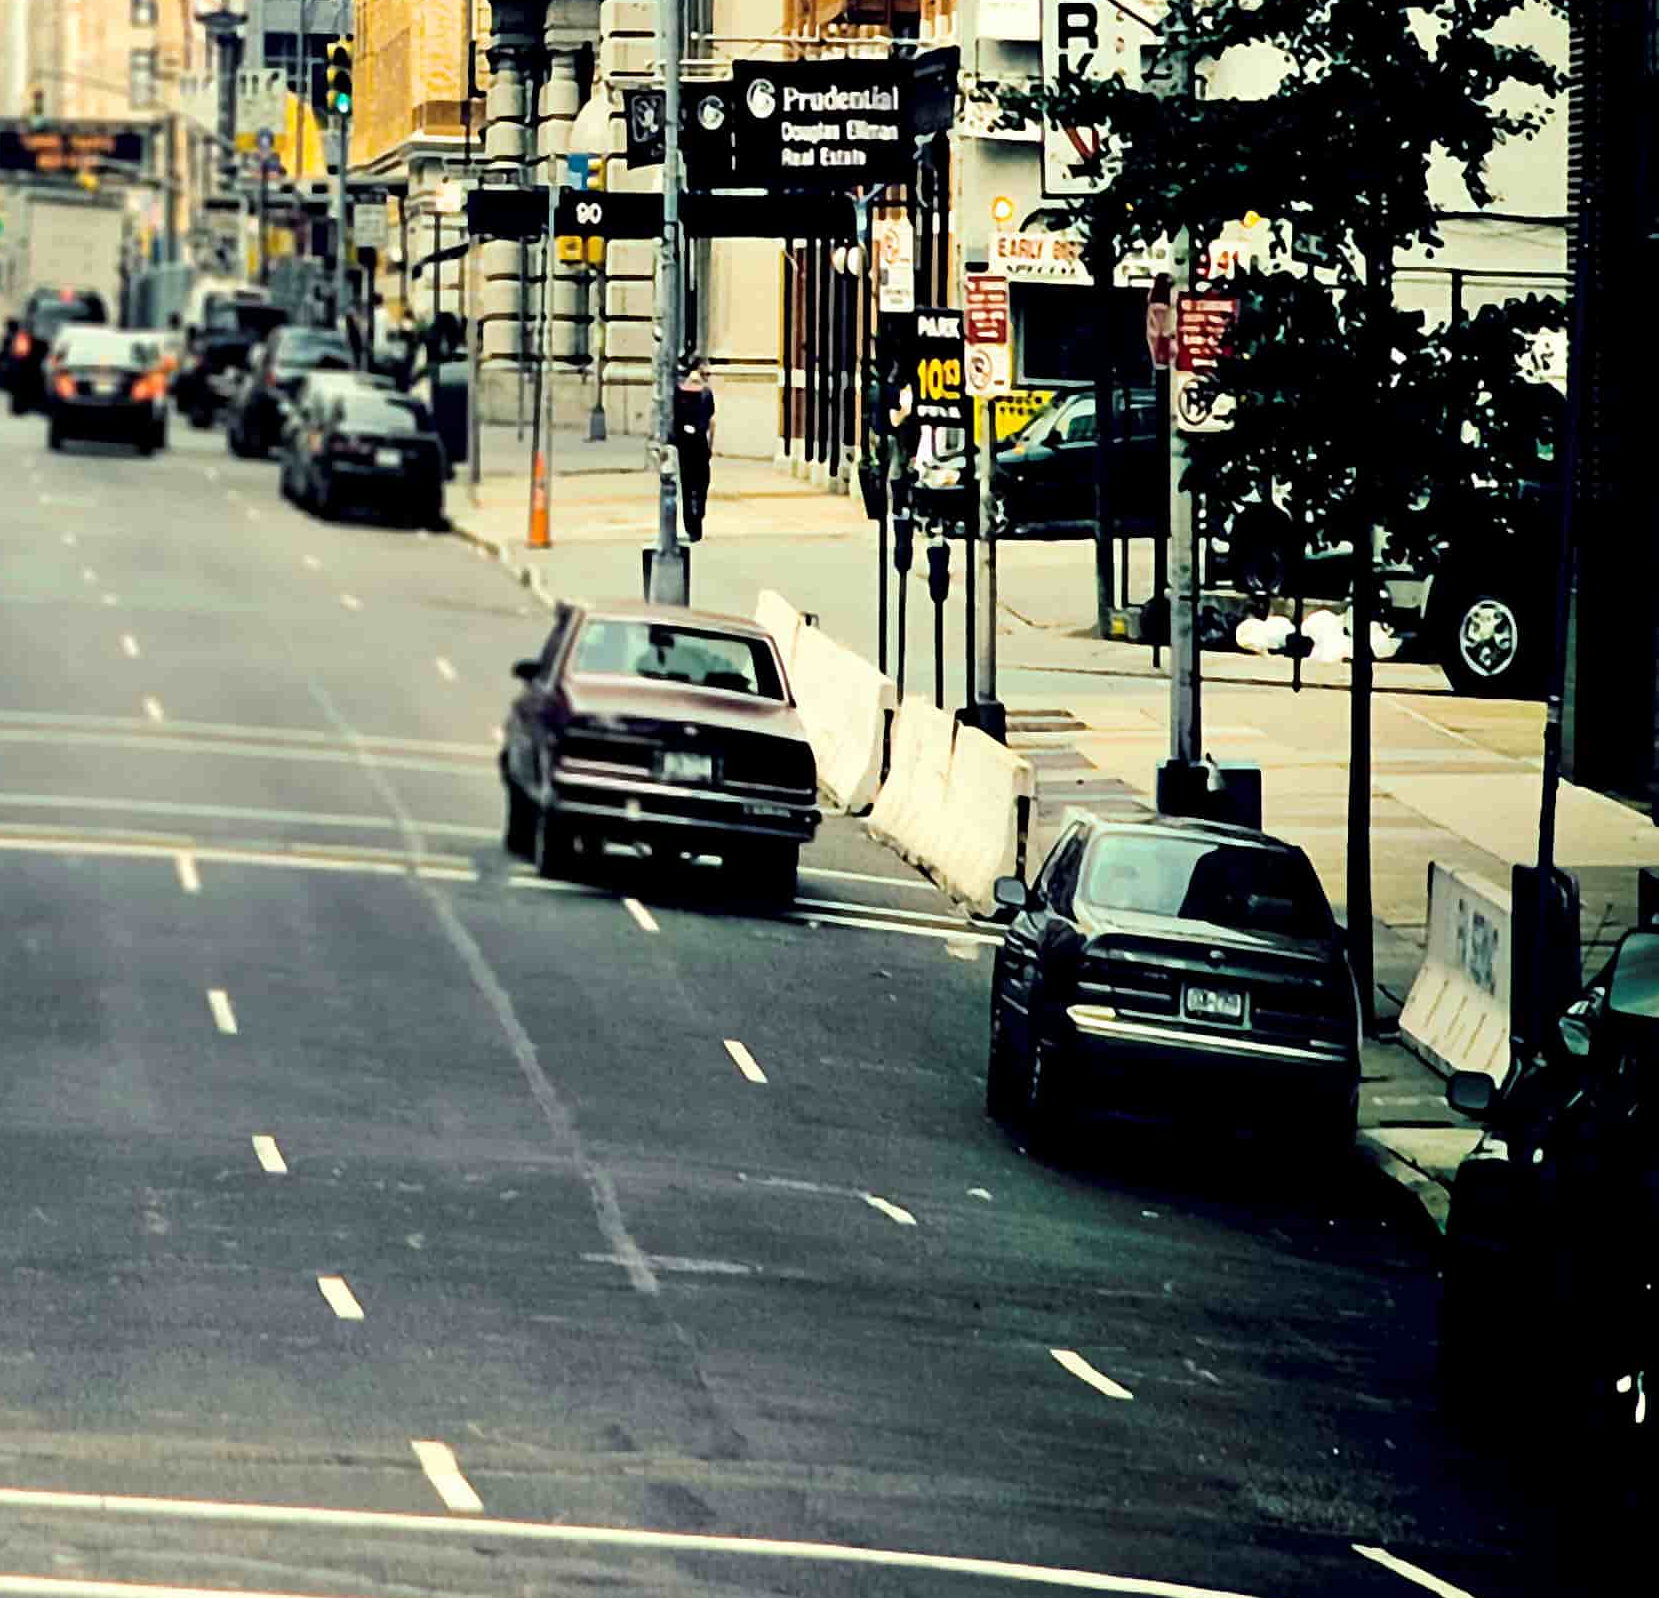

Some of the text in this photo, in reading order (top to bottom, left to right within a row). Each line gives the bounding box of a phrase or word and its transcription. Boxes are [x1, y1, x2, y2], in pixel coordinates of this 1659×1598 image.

[783, 84, 899, 111] Prudential
[781, 147, 867, 166] Real Estate
[998, 239, 1043, 259] EARLY
